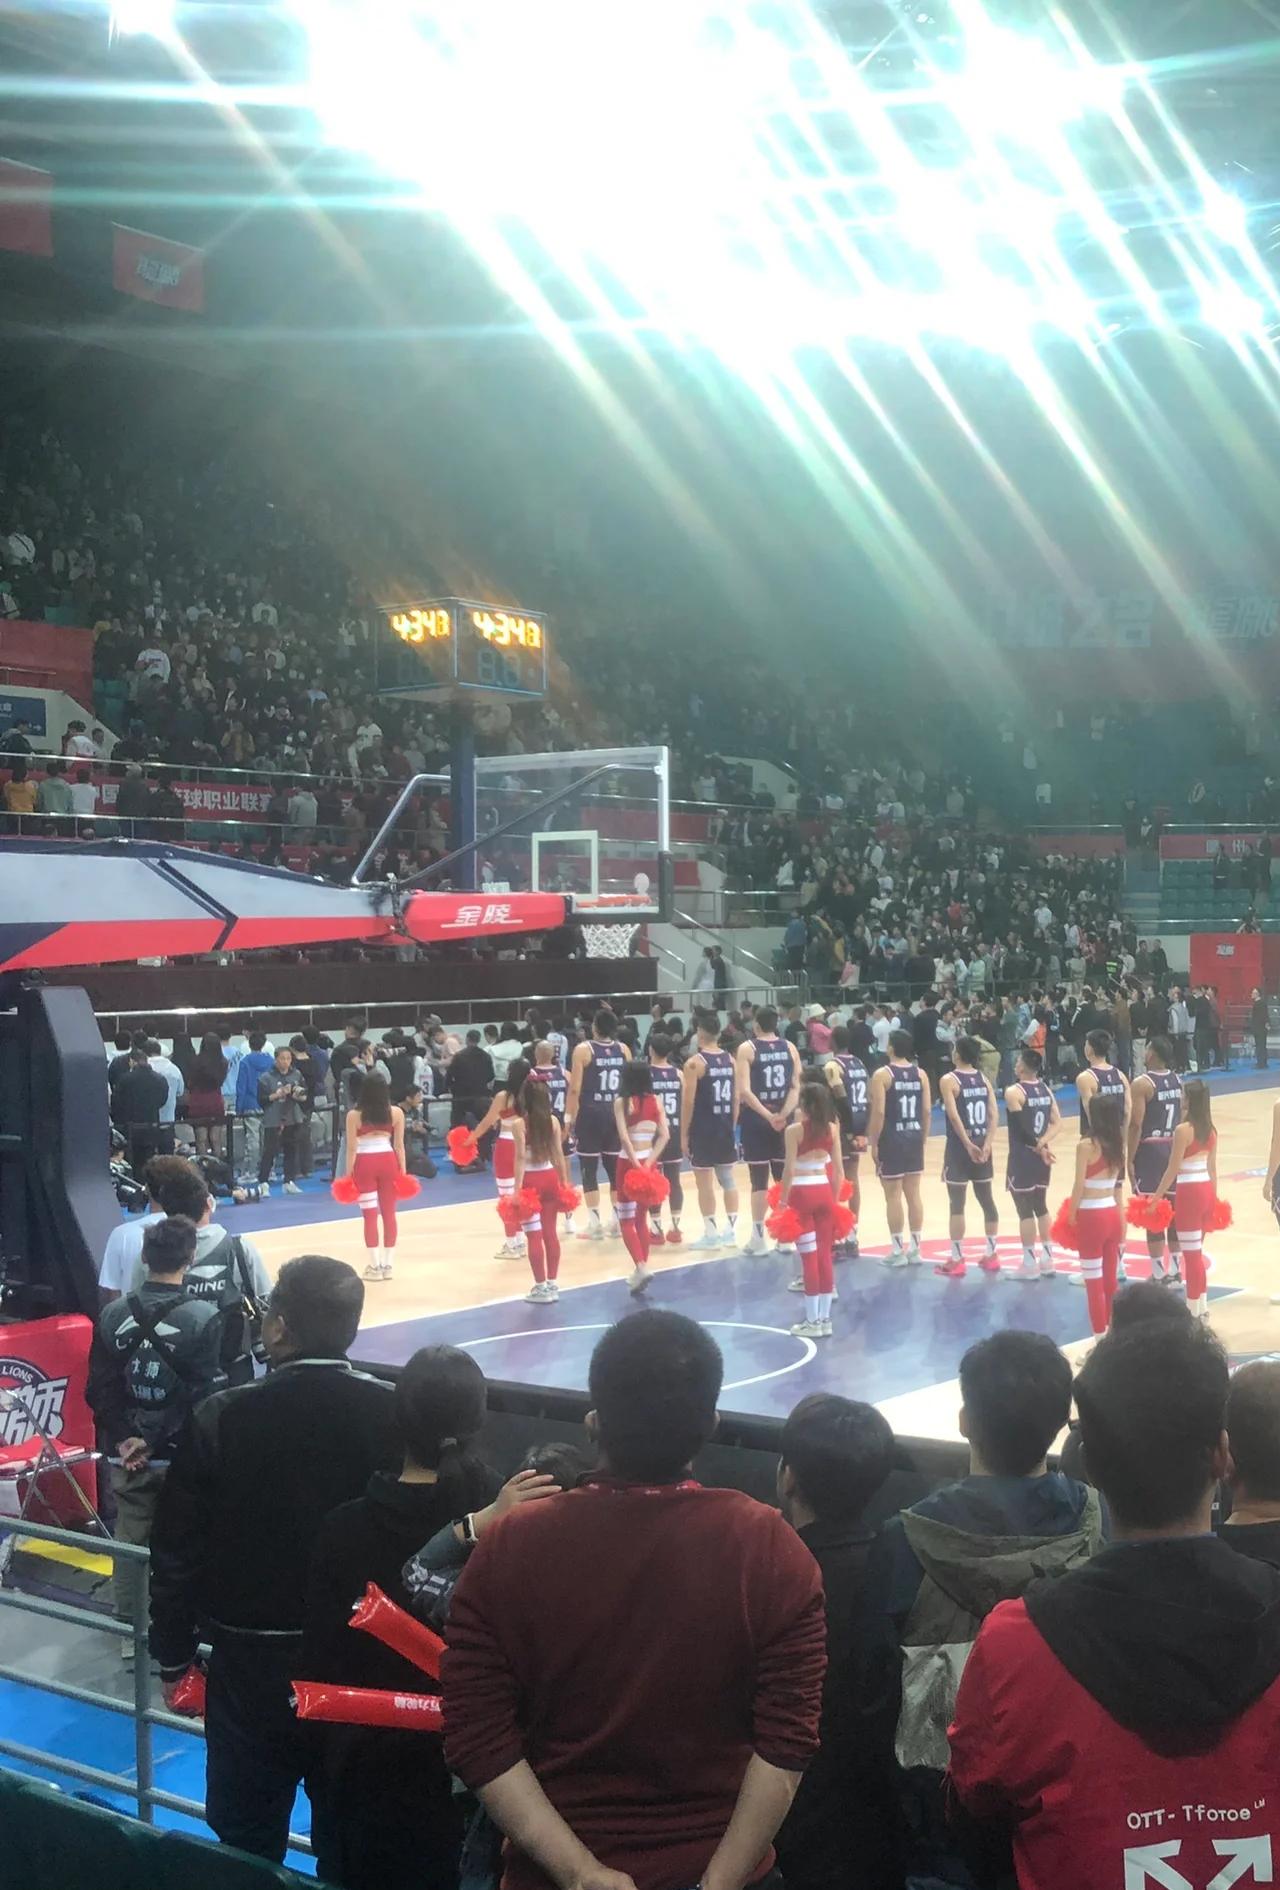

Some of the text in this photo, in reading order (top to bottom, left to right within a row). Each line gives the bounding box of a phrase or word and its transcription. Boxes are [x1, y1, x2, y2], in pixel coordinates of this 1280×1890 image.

[599, 1069, 620, 1091] 16
[763, 1064, 785, 1088] 13
[549, 1091, 566, 1112] 4
[712, 1079, 731, 1103] 14
[851, 1080, 867, 1104] 12
[899, 1094, 916, 1119] 11
[966, 1100, 986, 1125] 10
[1165, 1103, 1175, 1129] 7
[1034, 1111, 1046, 1134] 9
[2, 1365, 33, 1384] LIONS
